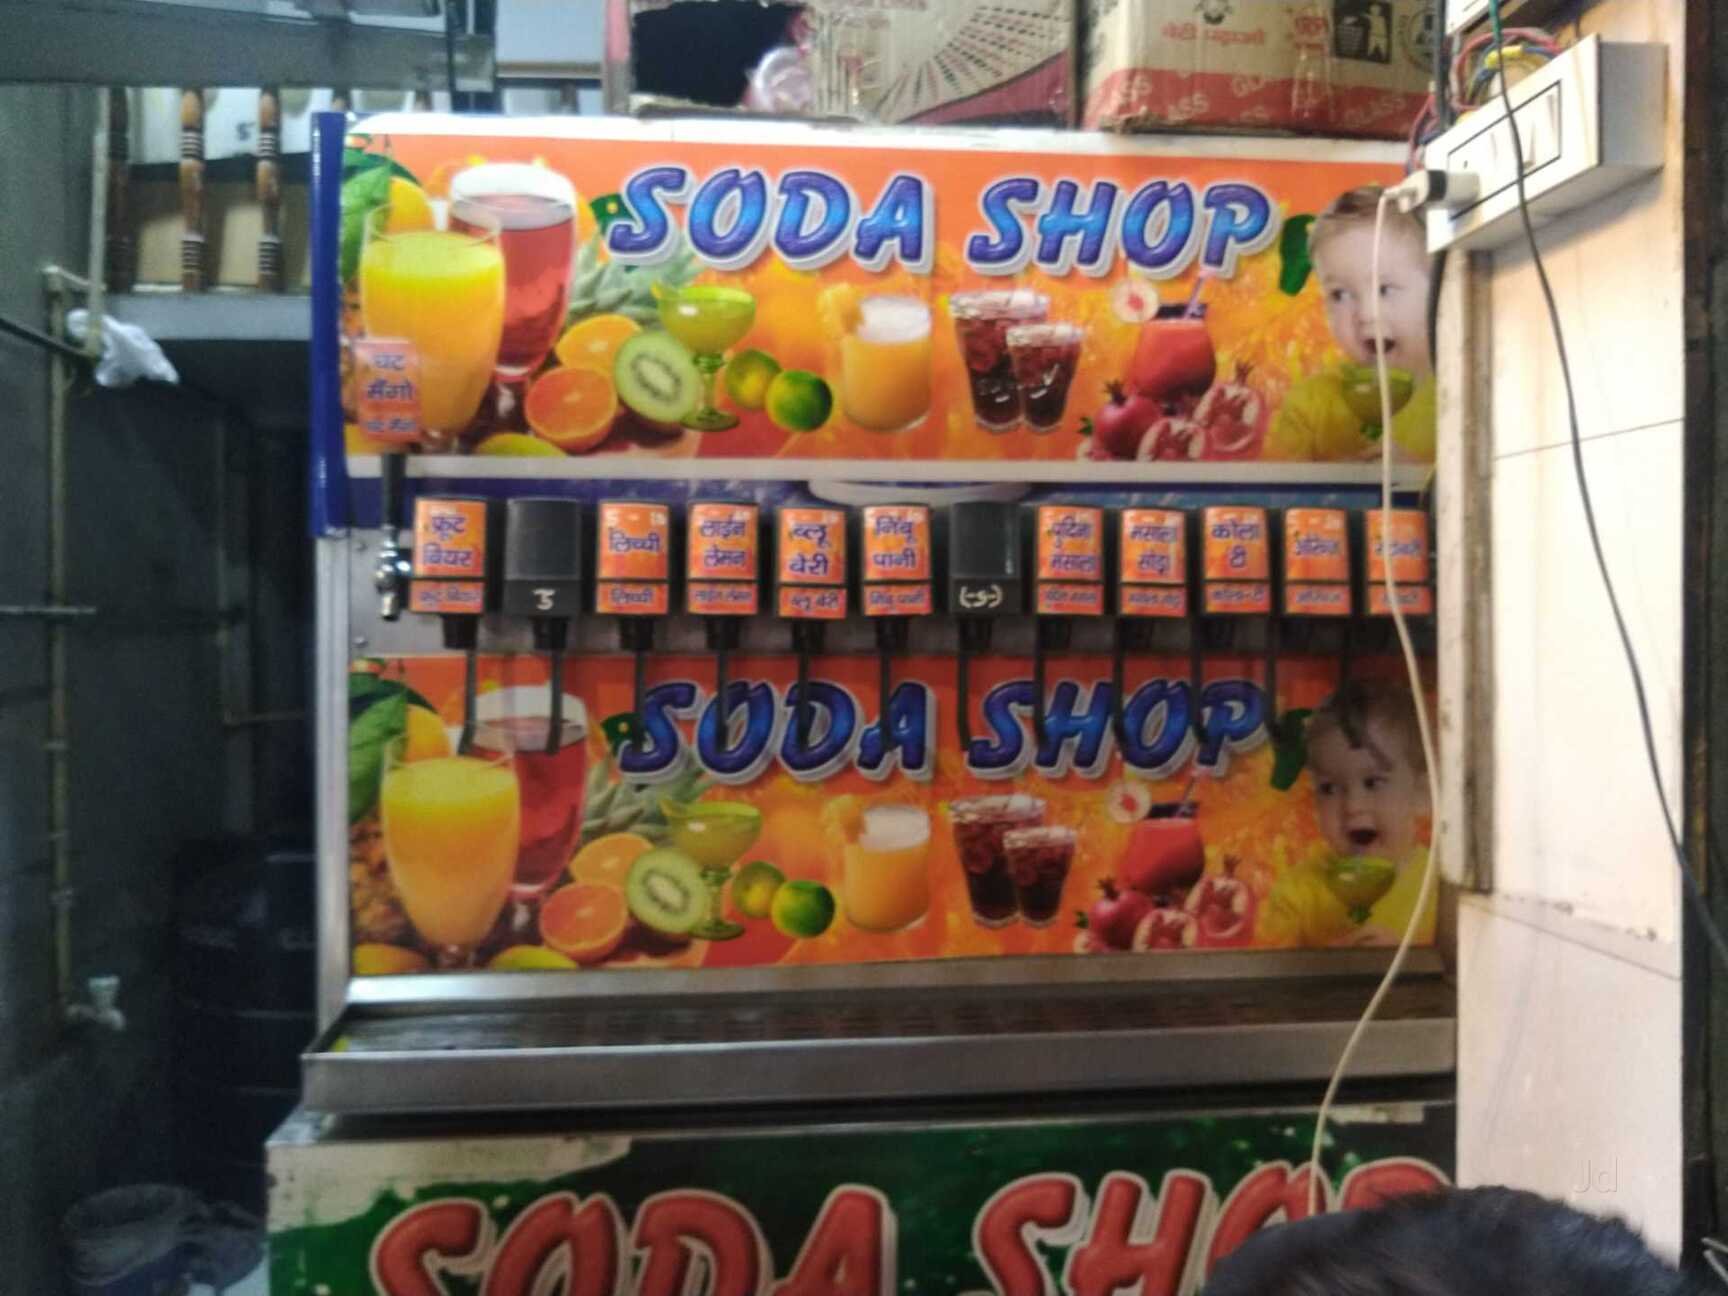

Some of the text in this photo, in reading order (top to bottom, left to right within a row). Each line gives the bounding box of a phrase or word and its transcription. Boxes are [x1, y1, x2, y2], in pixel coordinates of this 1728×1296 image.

[607, 164, 1277, 276] SODA SHOP
[1212, 518, 1261, 539] कोला
[703, 544, 747, 567] लेमन
[789, 553, 830, 576] बेरी
[872, 547, 917, 568] पानी
[1051, 554, 1098, 573] मसाला
[1229, 545, 1248, 568] टी
[617, 677, 1274, 782] SODA SHOP
[369, 1184, 898, 1296] SODA
